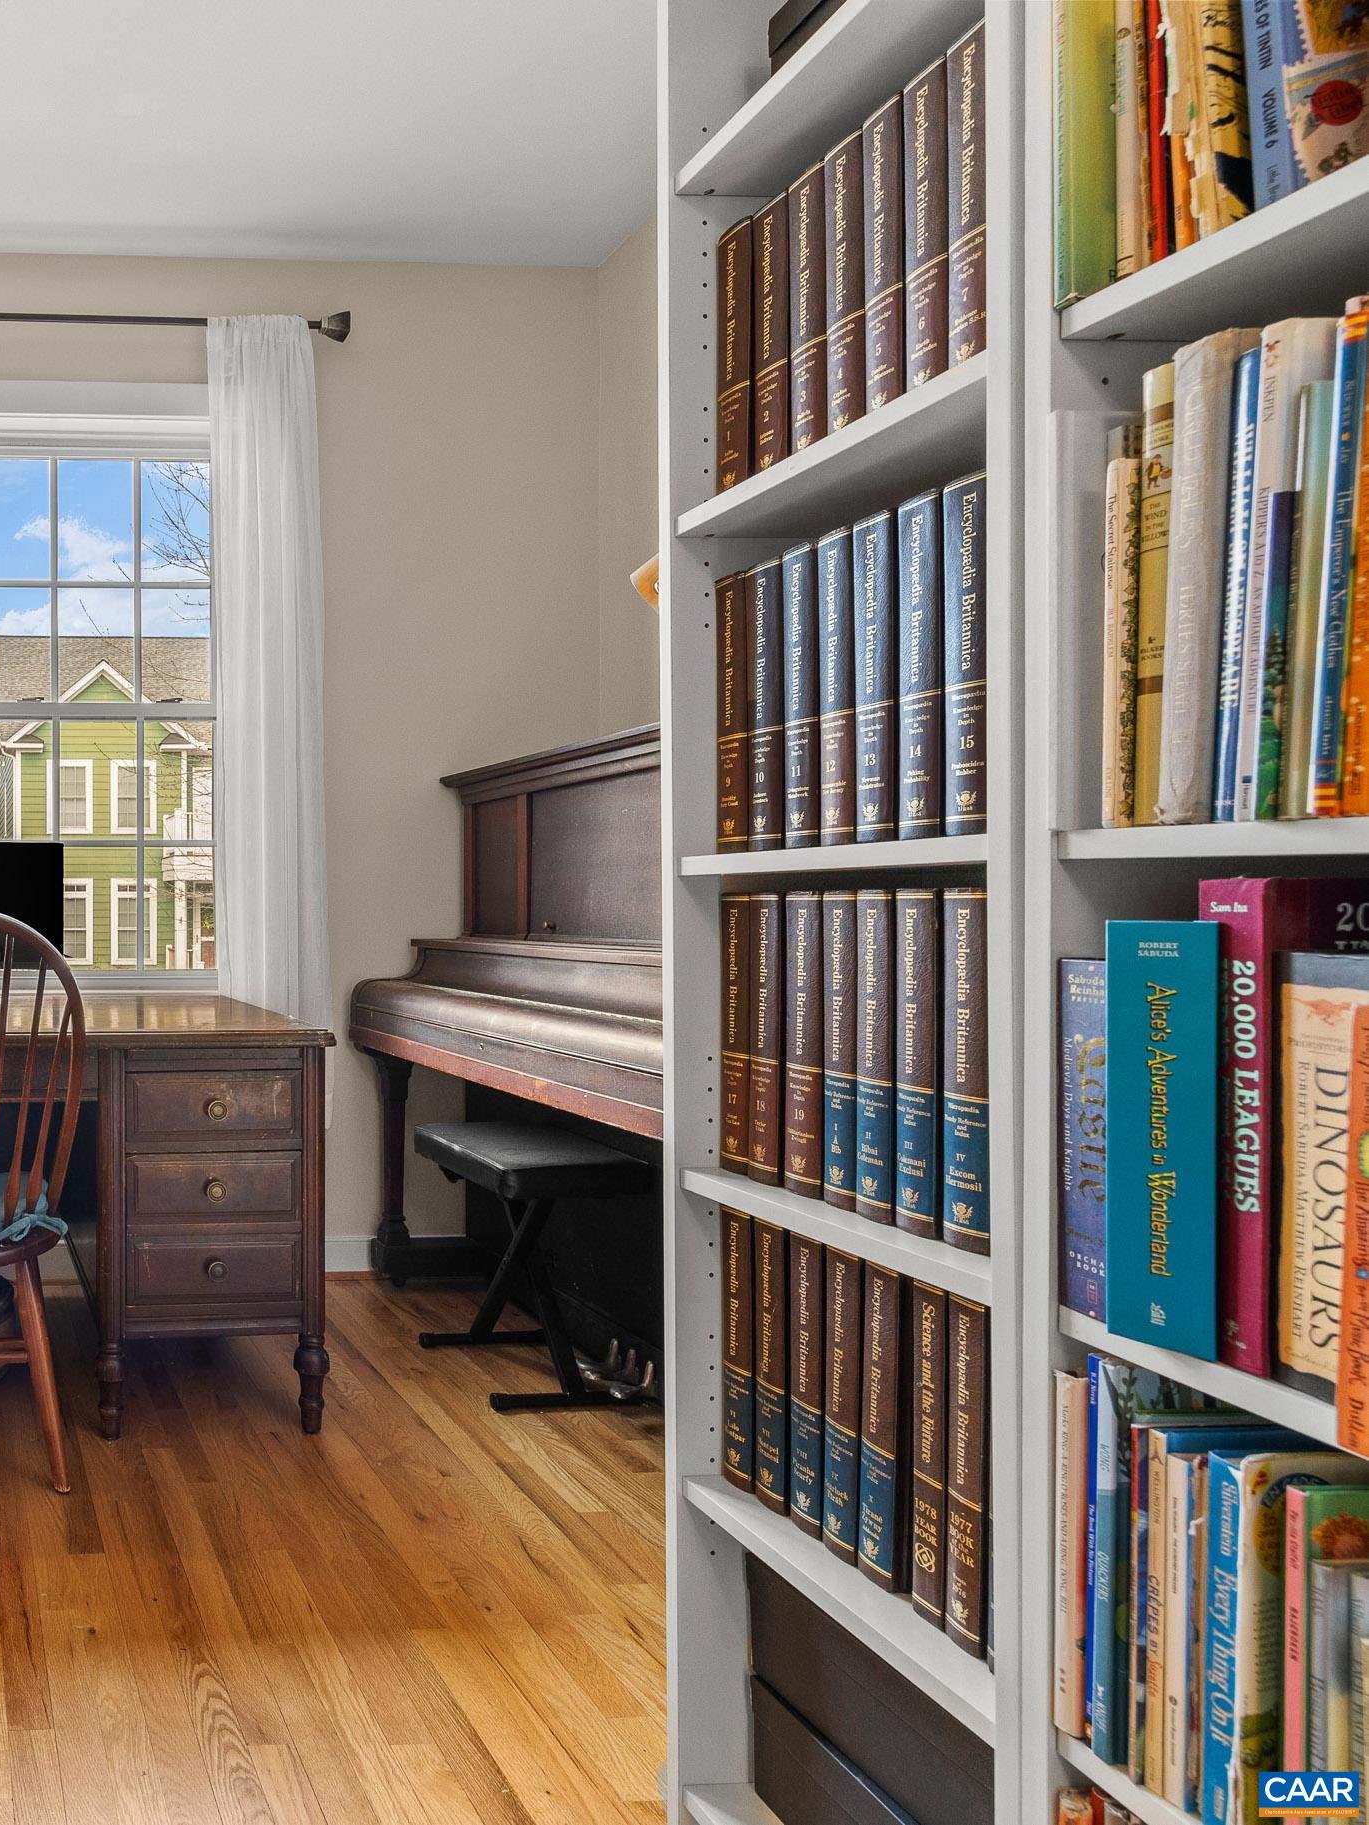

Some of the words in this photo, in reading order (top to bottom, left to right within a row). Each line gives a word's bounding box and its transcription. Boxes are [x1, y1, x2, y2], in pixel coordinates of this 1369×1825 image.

[1255, 13, 1271, 30] OF
[1256, 32, 1272, 71] TINTIN
[1262, 87, 1278, 139] VOLUME
[1265, 140, 1278, 149] 6
[1262, 374, 1278, 424] INKPEN
[1107, 493, 1118, 515] The
[1255, 485, 1271, 538] KIPPER'S
[1335, 488, 1353, 514] The
[1143, 508, 1168, 522] WIND
[1106, 517, 1118, 546] Secret
[1332, 519, 1352, 585] Emperor's
[1106, 546, 1118, 591] Staircase
[1330, 588, 1349, 616] New
[961, 593, 976, 671] Britannica
[1326, 622, 1345, 670] Clothes
[910, 744, 922, 759] 14
[959, 735, 975, 750] 15
[791, 765, 801, 778] 11
[826, 759, 837, 773] 12
[864, 753, 876, 767] 13
[725, 777, 731, 788] 9
[755, 771, 765, 784] 10
[1210, 901, 1231, 914] Sam
[1137, 949, 1180, 958] SABUDA
[1138, 941, 1180, 950] ROBERT
[1145, 981, 1178, 1043] Alice's
[1231, 960, 1257, 1060] 20,000
[956, 1008, 970, 1084] Britannica
[1062, 1036, 1073, 1088] Medieval
[728, 1093, 737, 1105] 17
[1145, 1045, 1178, 1150] Adventures
[1295, 1060, 1311, 1117] ROBERT
[756, 1100, 766, 1112] 18
[794, 1108, 805, 1121] 19
[1062, 1090, 1073, 1114] Days
[1064, 1122, 1073, 1145] and
[1233, 1067, 1261, 1214] LEAGUES
[956, 1153, 966, 1163] IV
[1152, 1153, 1166, 1166] in
[1294, 1120, 1310, 1178] SABUDA
[949, 1166, 976, 1181] Excom
[1063, 1148, 1074, 1192] Knights
[945, 1175, 982, 1193] Hermosil
[1308, 1066, 1349, 1351] DINOSAURS
[1145, 1171, 1177, 1279] Wonderland
[1293, 1190, 1309, 1261] MATTHEW
[1069, 1250, 1106, 1269] ORCHA
[1291, 1265, 1308, 1339] REINHART
[922, 1301, 936, 1356] Science
[922, 1358, 935, 1387] and
[922, 1388, 935, 1413] the
[922, 1414, 935, 1463] Future
[956, 1409, 970, 1485] Britannica
[914, 1497, 937, 1520] 1978
[915, 1514, 937, 1536] YEAR
[951, 1511, 973, 1534] 1977
[914, 1525, 938, 1547] BOOK
[949, 1524, 974, 1550] BOOK
[949, 1542, 975, 1569] YEAR
[1096, 1551, 1111, 1603] QUACKERS
[1208, 1565, 1238, 1628] Every
